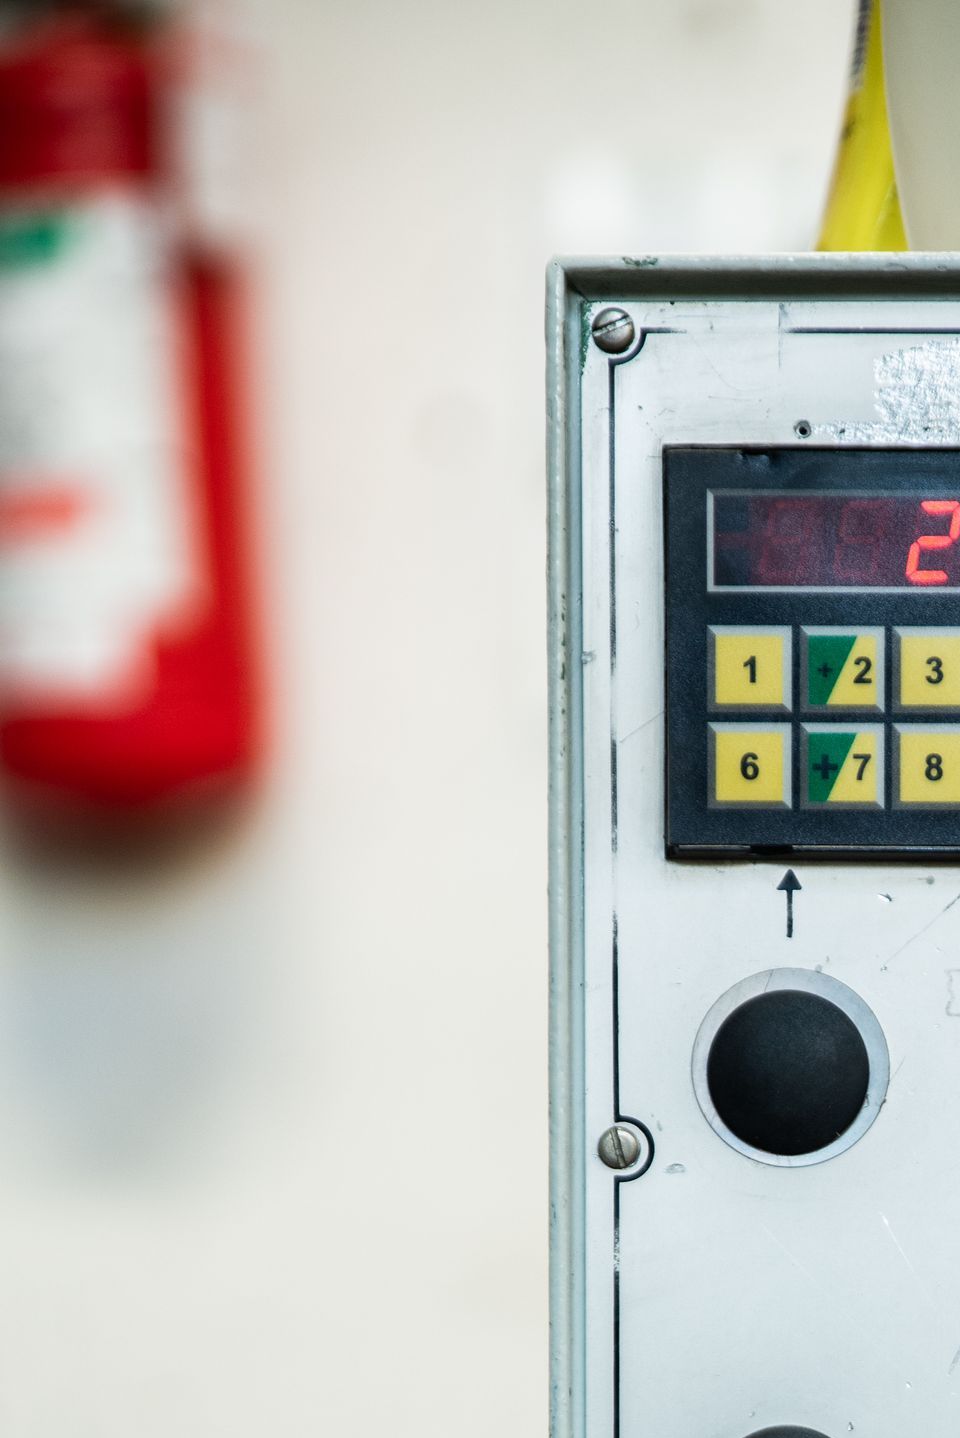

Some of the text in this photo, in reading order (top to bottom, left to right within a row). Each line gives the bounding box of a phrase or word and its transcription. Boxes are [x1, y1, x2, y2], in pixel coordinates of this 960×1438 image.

[743, 656, 757, 683] 1
[853, 656, 873, 684] 2
[925, 656, 944, 684] 3
[740, 752, 759, 781] 6
[852, 753, 872, 781] 7
[924, 753, 943, 781] 8
